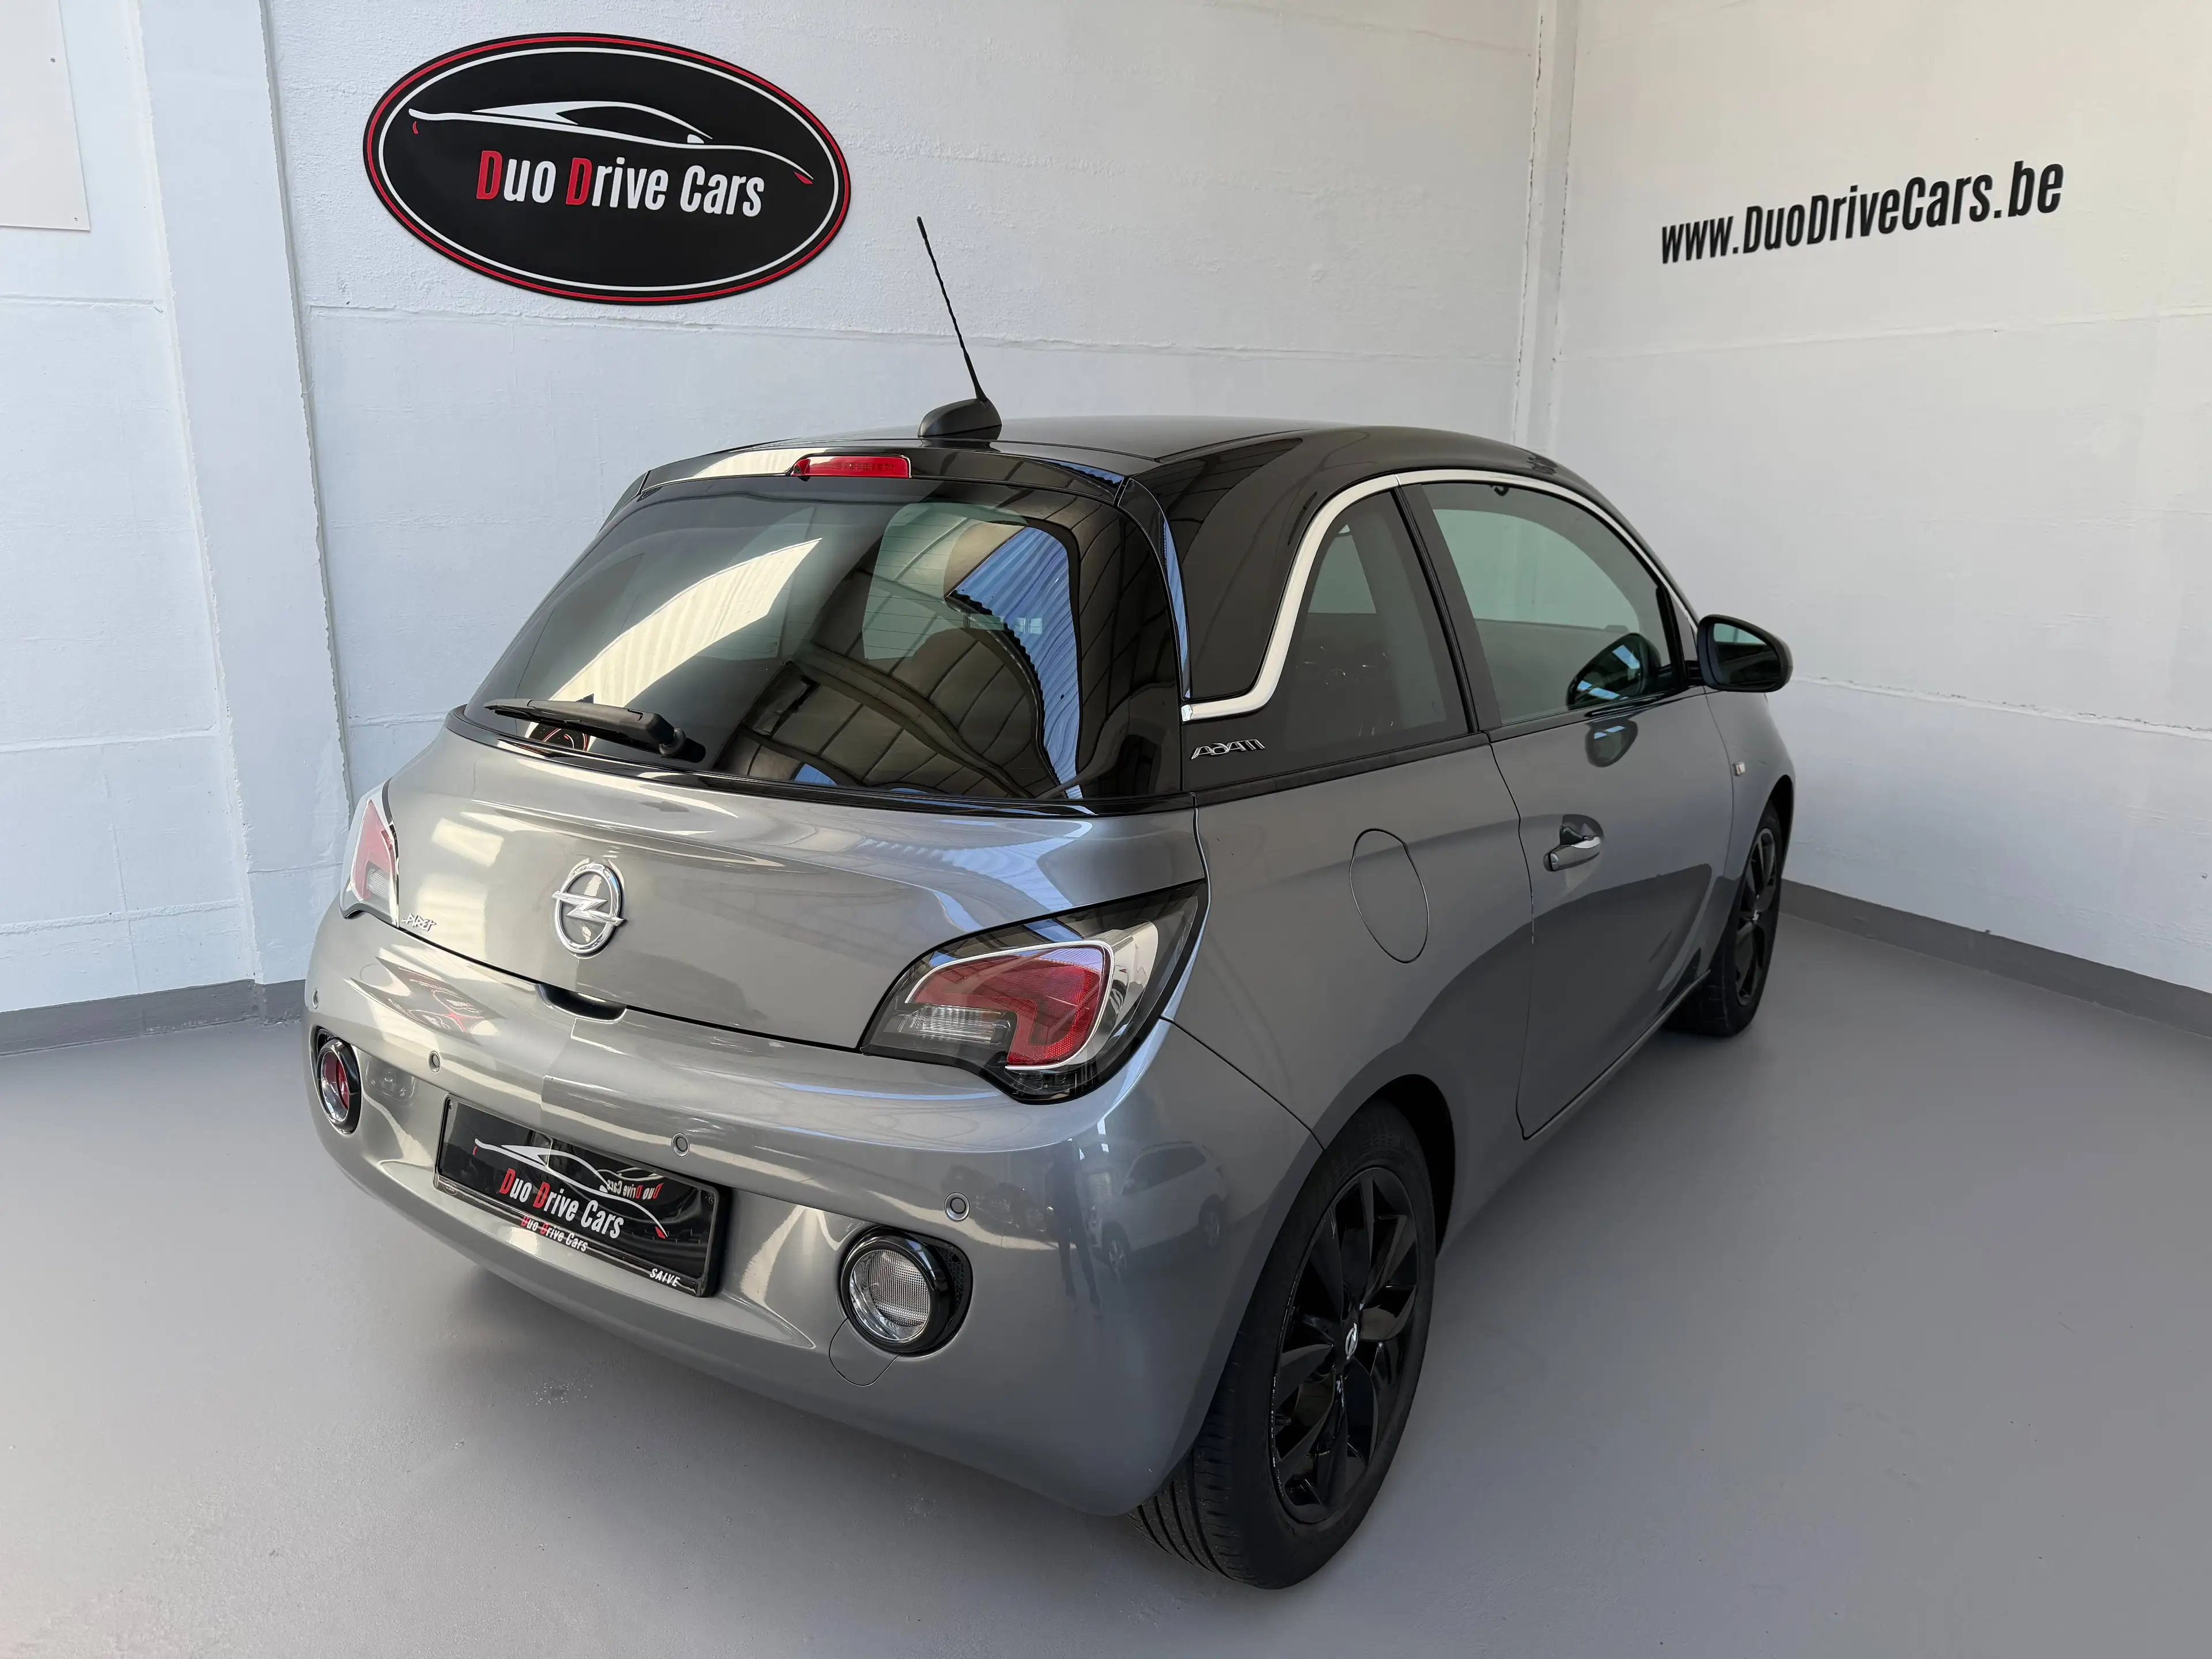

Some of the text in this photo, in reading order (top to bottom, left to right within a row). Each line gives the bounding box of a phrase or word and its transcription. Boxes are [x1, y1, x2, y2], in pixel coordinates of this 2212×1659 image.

[476, 150, 764, 217] Duo Drive Cars
[1661, 160, 2065, 264] www.DuoDriveCars.be
[499, 1168, 624, 1238] Duo Drive Cars
[521, 1217, 588, 1252] Duo Drive Cars
[650, 1268, 681, 1287] SAIVE
